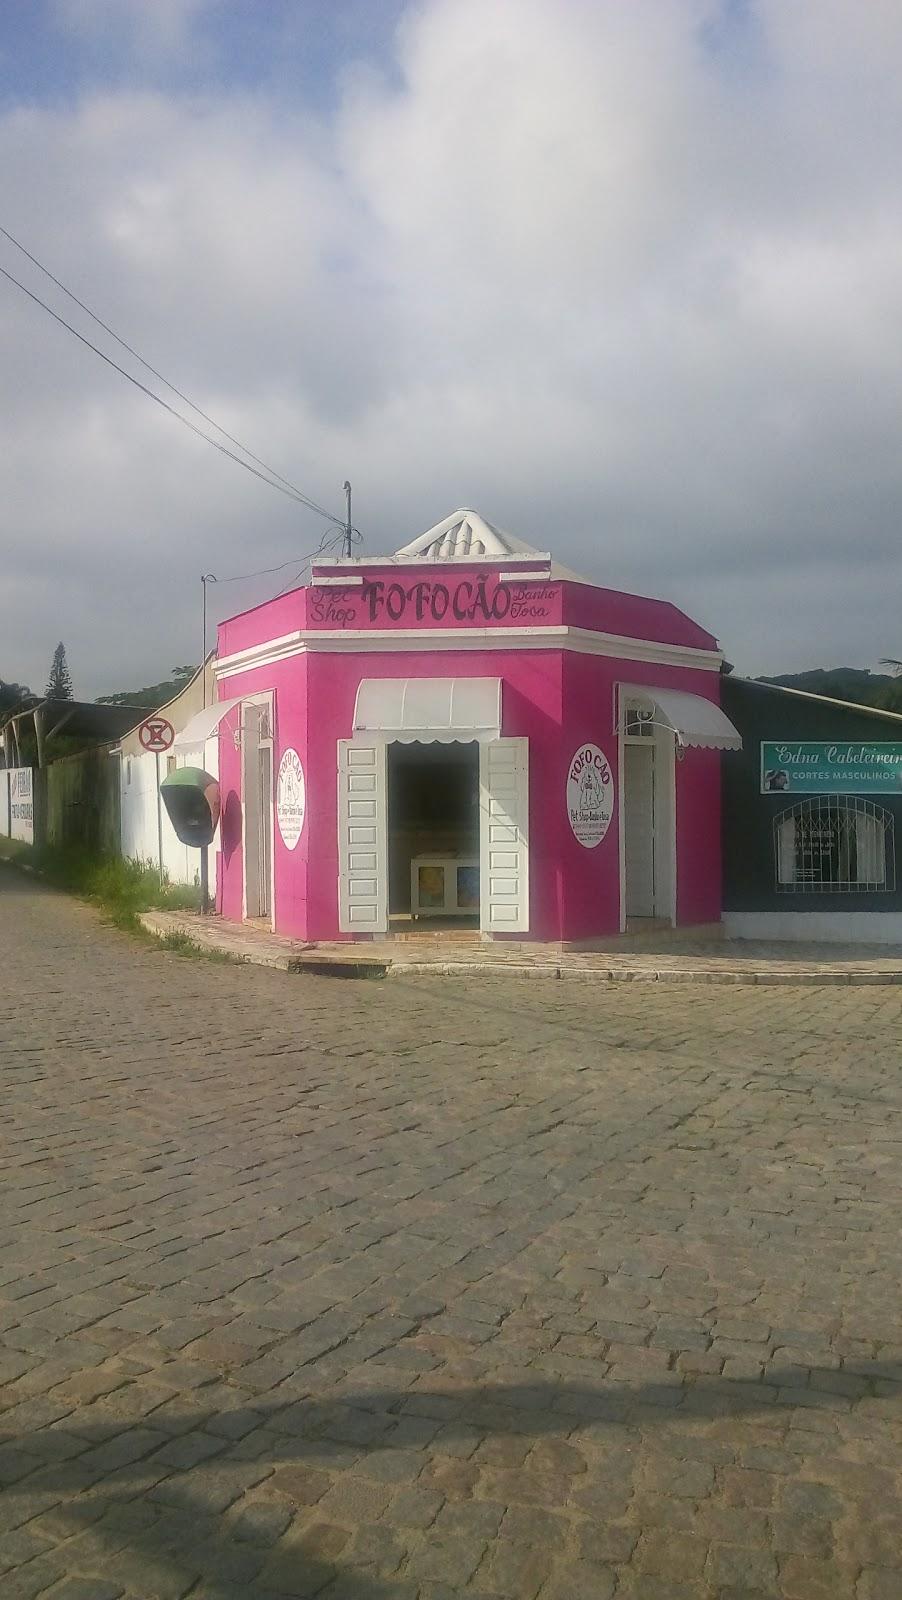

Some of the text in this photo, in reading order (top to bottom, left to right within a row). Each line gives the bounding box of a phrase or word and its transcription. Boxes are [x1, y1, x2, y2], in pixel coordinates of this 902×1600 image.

[362, 574, 511, 622] FOFOCÃO
[310, 603, 356, 628] Shop
[775, 746, 902, 764] Edna Cabeleireir
[792, 771, 896, 780] CORTES MASCULINOS
